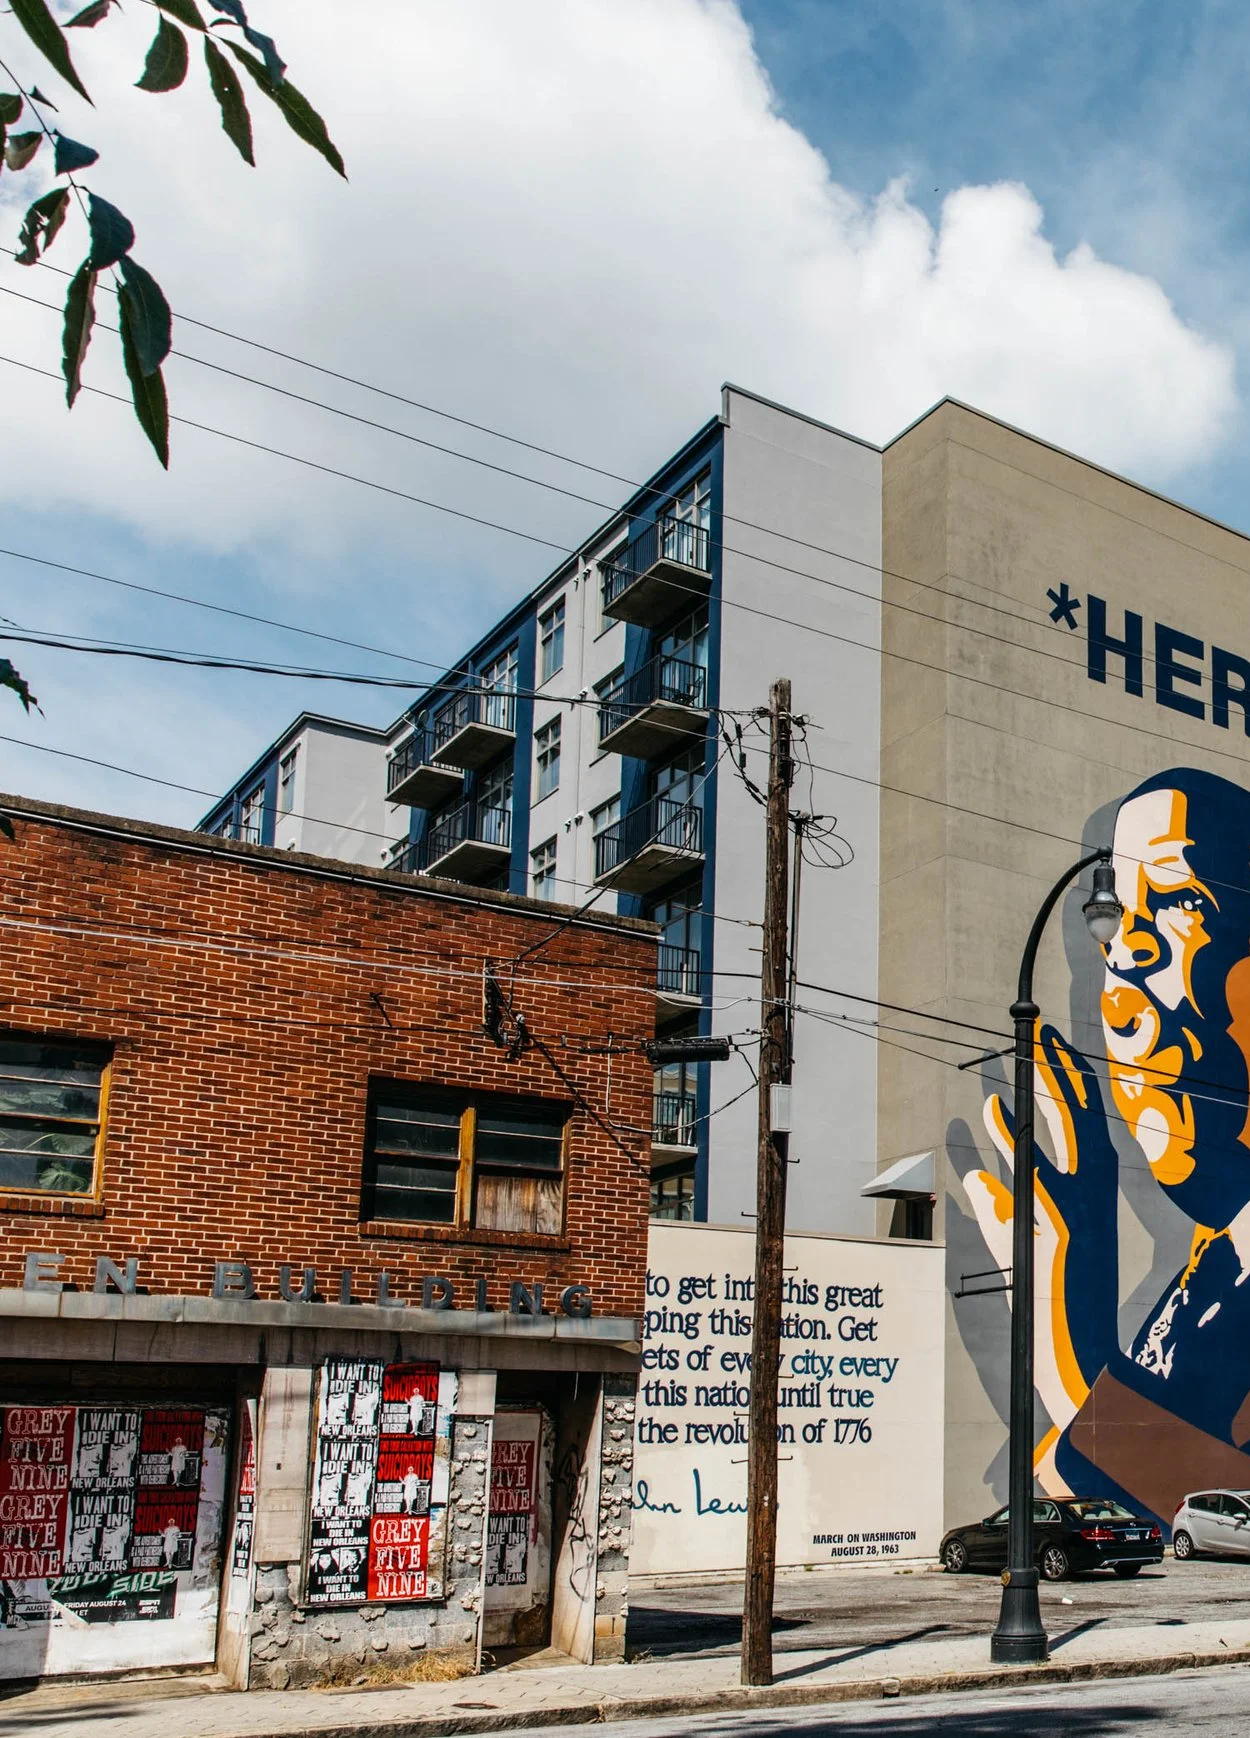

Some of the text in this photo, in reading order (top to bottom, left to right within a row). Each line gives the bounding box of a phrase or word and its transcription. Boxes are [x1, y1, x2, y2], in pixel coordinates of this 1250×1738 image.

[24, 1252, 593, 1318] EN BUILDING
[646, 1268, 670, 1297] to
[677, 1273, 717, 1305] get
[724, 1273, 756, 1301] int
[825, 1282, 884, 1311] great
[643, 1305, 701, 1340] ping
[708, 1308, 752, 1337] this
[838, 1315, 879, 1342] Get
[641, 1342, 680, 1371] ets
[686, 1344, 715, 1371] of
[791, 1348, 834, 1382] city,
[839, 1355, 900, 1383] every
[330, 1363, 335, 1380] I
[337, 1363, 366, 1380] WANT
[368, 1363, 379, 1380] TO
[358, 1380, 373, 1393] IN
[641, 1380, 875, 1409] this natio until true
[7, 1408, 72, 1436] GREY
[83, 1413, 87, 1431] I
[90, 1413, 122, 1431] WANT
[125, 1413, 138, 1431] TO
[321, 1423, 378, 1436] NEW ORLEANS
[114, 1431, 130, 1444] IN
[638, 1417, 679, 1444] the
[802, 1417, 829, 1444] of
[833, 1417, 873, 1445] 1776
[8, 1437, 65, 1464] FIVE
[323, 1443, 328, 1460] I
[330, 1442, 360, 1460] WANT
[361, 1442, 373, 1459] TO
[351, 1460, 366, 1473] IN
[10, 1465, 68, 1491] NINE
[72, 1477, 135, 1489] NEW ORLEANS
[75, 1497, 80, 1515] I
[82, 1496, 114, 1514] WANT
[117, 1495, 130, 1513] TO
[489, 1489, 530, 1511] NINE
[631, 1480, 682, 1514] hn
[0, 1494, 64, 1521] GREY
[313, 1505, 371, 1518] NEW ORLEANS
[107, 1514, 123, 1527] IN
[321, 1519, 363, 1529] I WANT TO
[489, 1517, 526, 1533] WANT TO
[0, 1523, 58, 1550] FIVE
[328, 1529, 355, 1538] DIE IN
[372, 1519, 426, 1545] GREY
[813, 1531, 917, 1545] MARCH ON WASHINGTON
[313, 1537, 369, 1546] NEW ORLEANS
[831, 1543, 900, 1557] AUGUST 28, 1963
[1, 1550, 61, 1578] NINE
[65, 1560, 128, 1573] NEW ORLEANS
[374, 1545, 421, 1571] FIVE
[318, 1575, 360, 1584] I WANT TO
[376, 1571, 425, 1597] NINE
[495, 1572, 526, 1583] ORLEANS
[310, 1592, 367, 1602] NEW ORLEANS
[325, 1584, 352, 1593] DIE IN
[64, 1601, 90, 1609] FRIDAY
